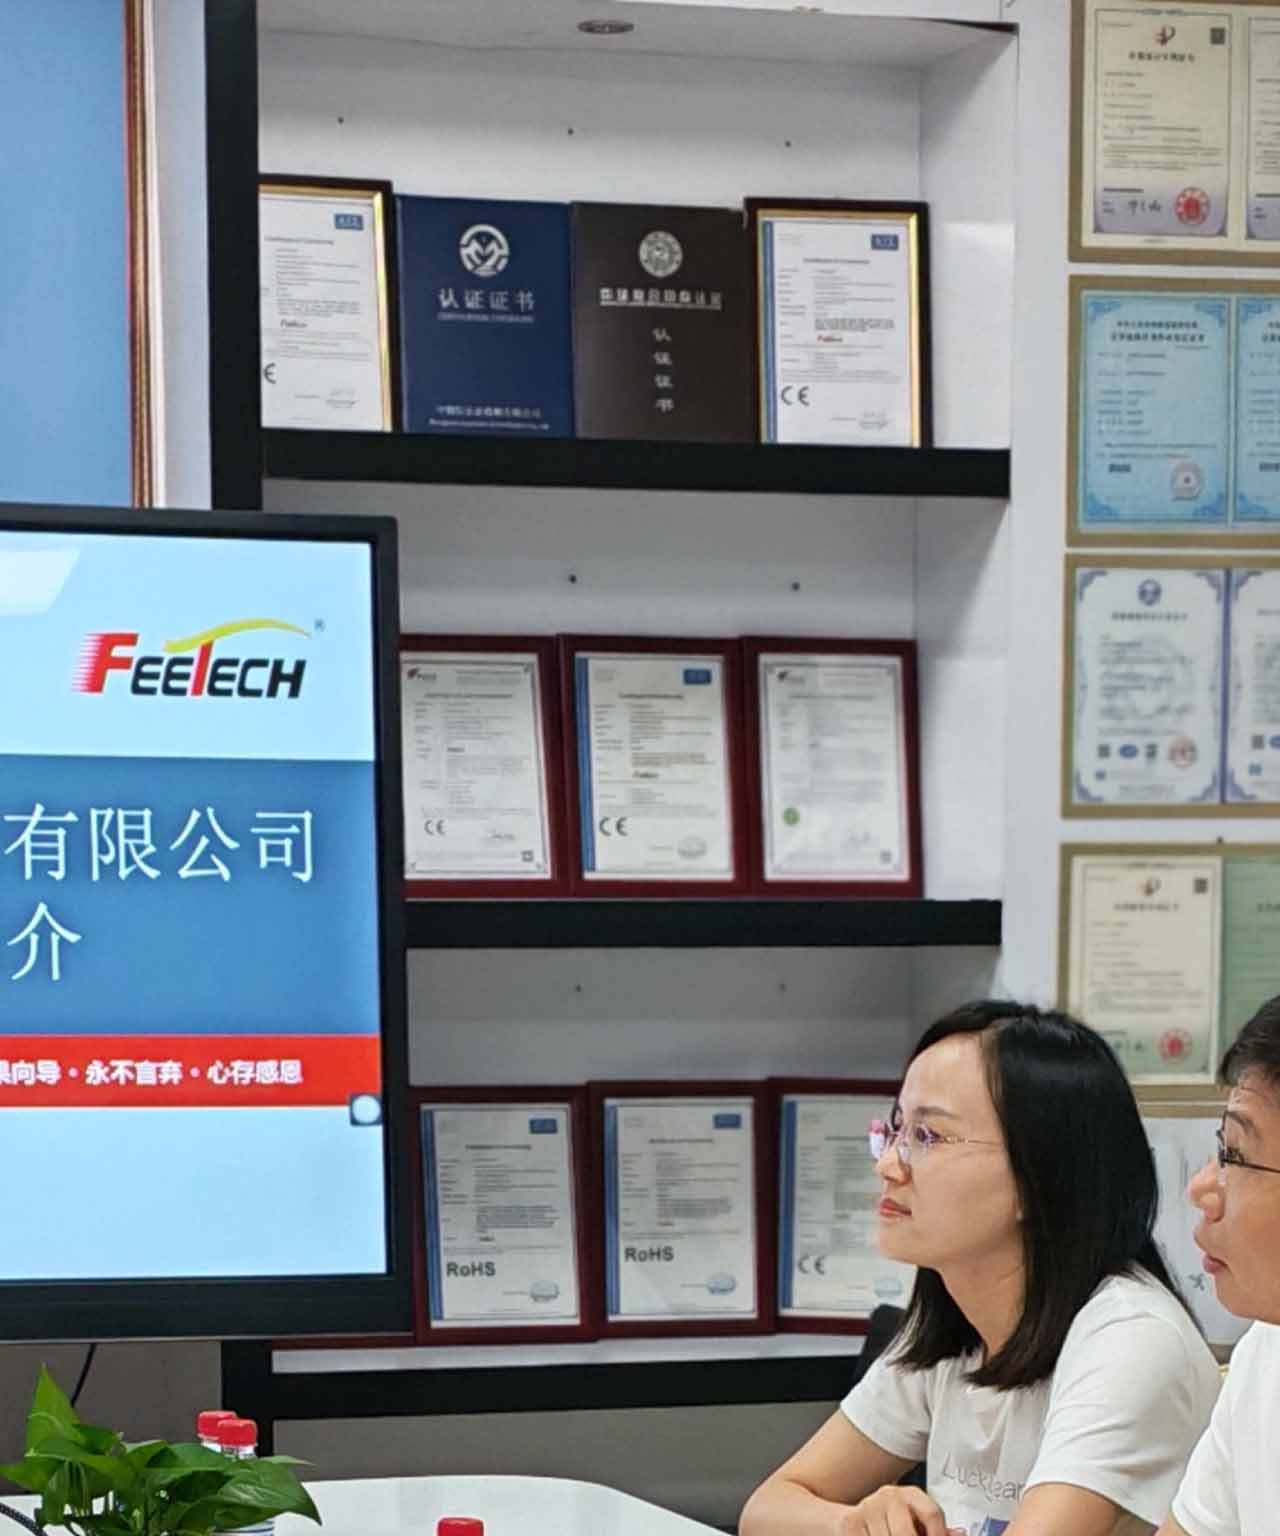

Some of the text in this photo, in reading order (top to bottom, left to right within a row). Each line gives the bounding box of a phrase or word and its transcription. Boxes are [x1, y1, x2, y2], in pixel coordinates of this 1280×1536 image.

[437, 288, 535, 312] 认证证书
[780, 385, 810, 407] CE
[72, 620, 311, 698] FEETECH
[598, 816, 628, 837] CE
[624, 1246, 675, 1262] RoHS
[446, 1261, 496, 1277] RoHS
[797, 1255, 827, 1275] CE
